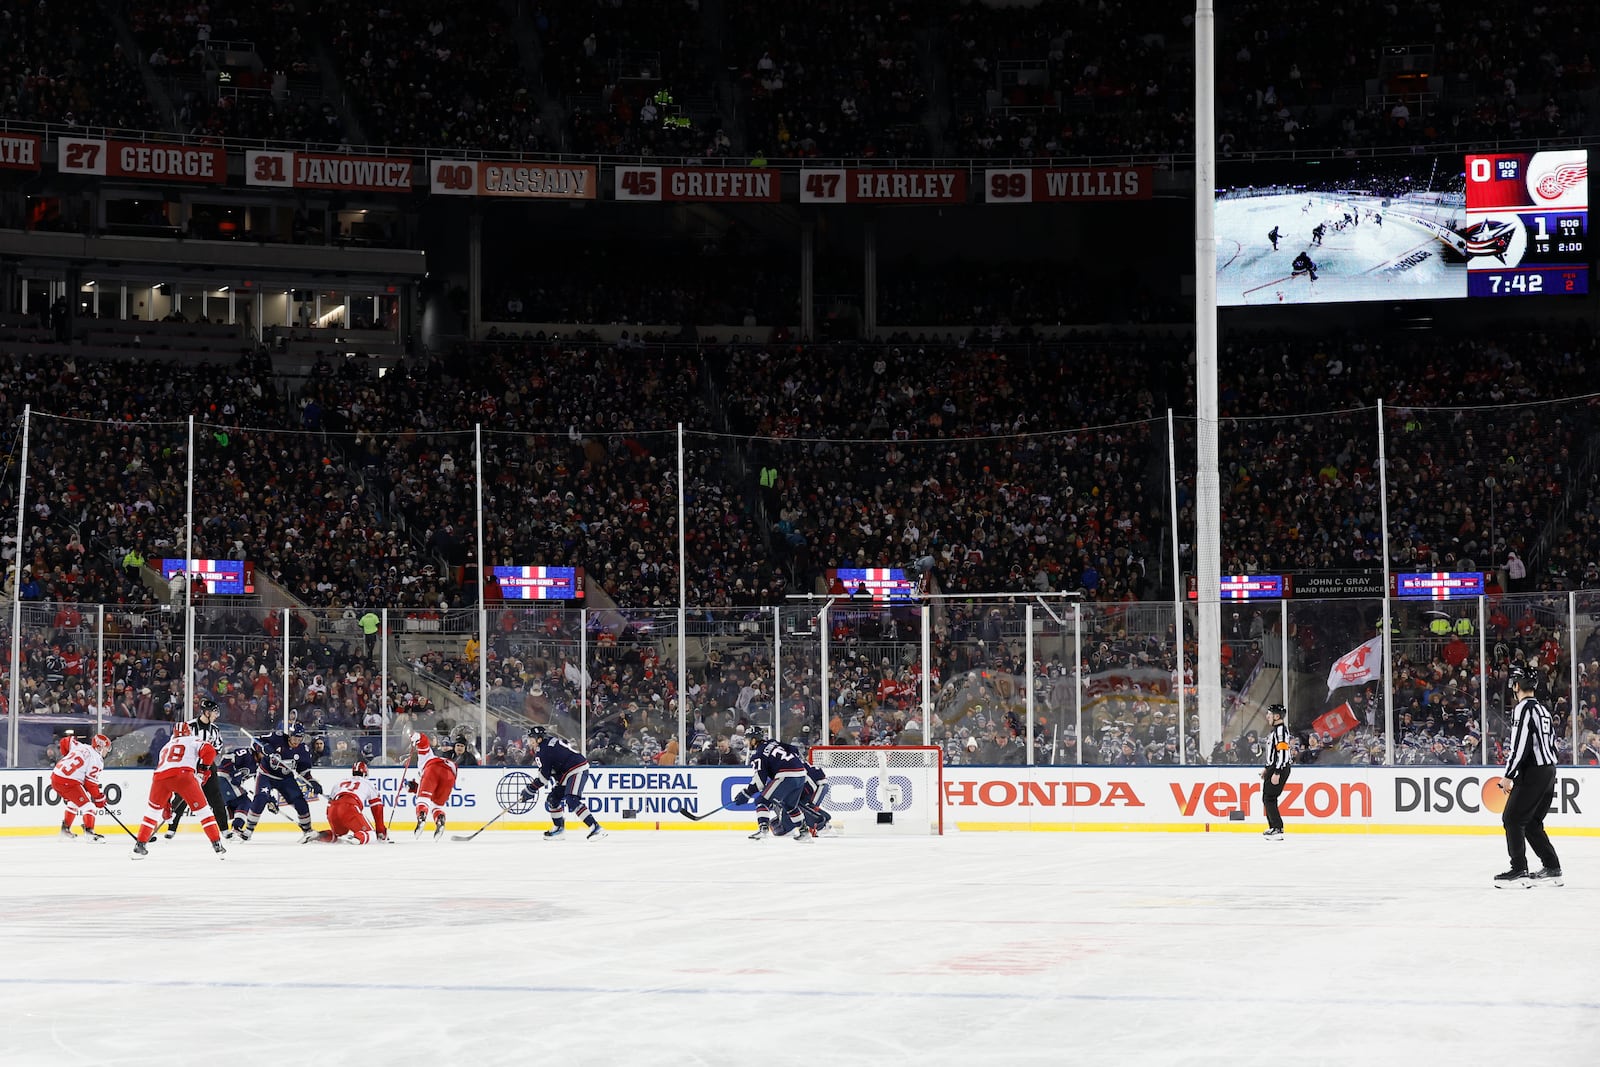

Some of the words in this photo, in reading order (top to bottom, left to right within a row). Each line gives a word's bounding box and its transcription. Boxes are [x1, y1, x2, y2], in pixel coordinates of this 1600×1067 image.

[66, 143, 101, 169] 27
[120, 146, 214, 177] GEORGE
[1498, 161, 1518, 170] SOG
[254, 156, 285, 182] 31
[297, 157, 411, 188] JANOWICZ
[436, 164, 473, 191] 40
[485, 166, 588, 195] CASSADY
[1471, 159, 1491, 182] 0
[1501, 169, 1515, 178] 22
[620, 171, 656, 195] 45
[671, 171, 771, 198] GRIFFIN
[806, 174, 840, 198] 47
[856, 173, 956, 198] HARLEY
[990, 174, 1026, 198] 99
[1046, 171, 1139, 197] WILLIS
[1534, 217, 1550, 241] 1
[1560, 219, 1579, 228] SOG
[1563, 228, 1576, 236] 11
[1536, 244, 1550, 253] 15
[1558, 243, 1582, 252] 2:00
[1489, 274, 1543, 293] 7:42
[1565, 280, 1574, 291] 2
[1308, 578, 1332, 586] JOHN
[1334, 578, 1344, 586] C.
[1345, 577, 1370, 585] GRAY
[1343, 585, 1384, 593] ENTRANCE
[608, 773, 698, 790] FEDERAL
[943, 780, 1145, 807] HONDA
[1169, 782, 1372, 818] verzon
[628, 797, 698, 813] UNION
